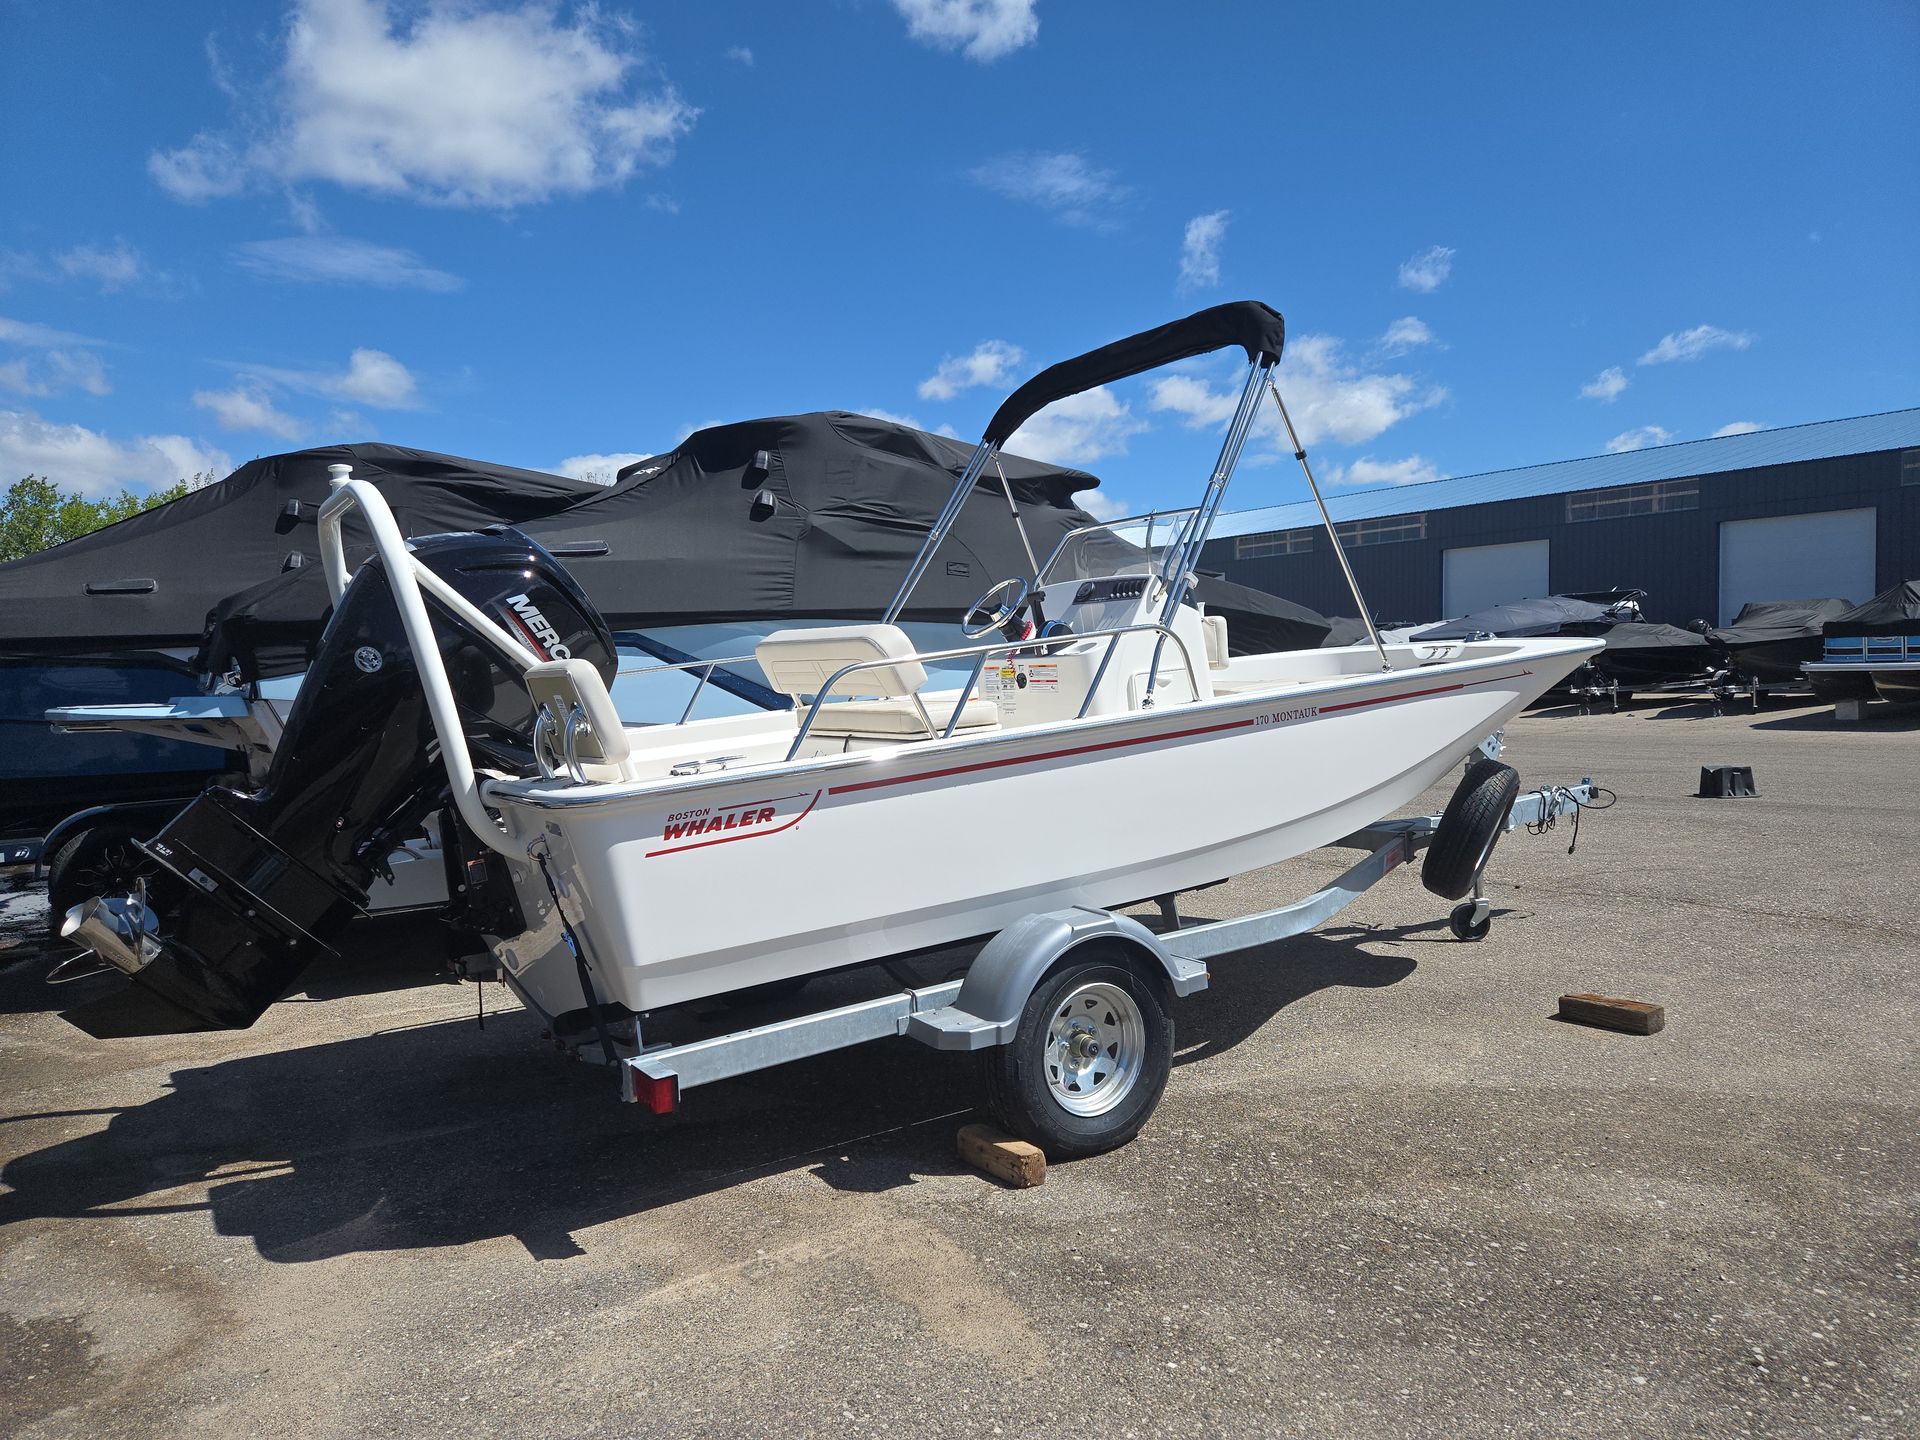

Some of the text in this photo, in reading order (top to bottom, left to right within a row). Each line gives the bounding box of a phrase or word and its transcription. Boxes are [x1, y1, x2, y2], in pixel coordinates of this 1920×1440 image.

[505, 593, 571, 661] MERC
[1255, 706, 1318, 726] 170 MONTAUK
[663, 806, 776, 841] WHALER
[667, 808, 711, 822] BOSTON
